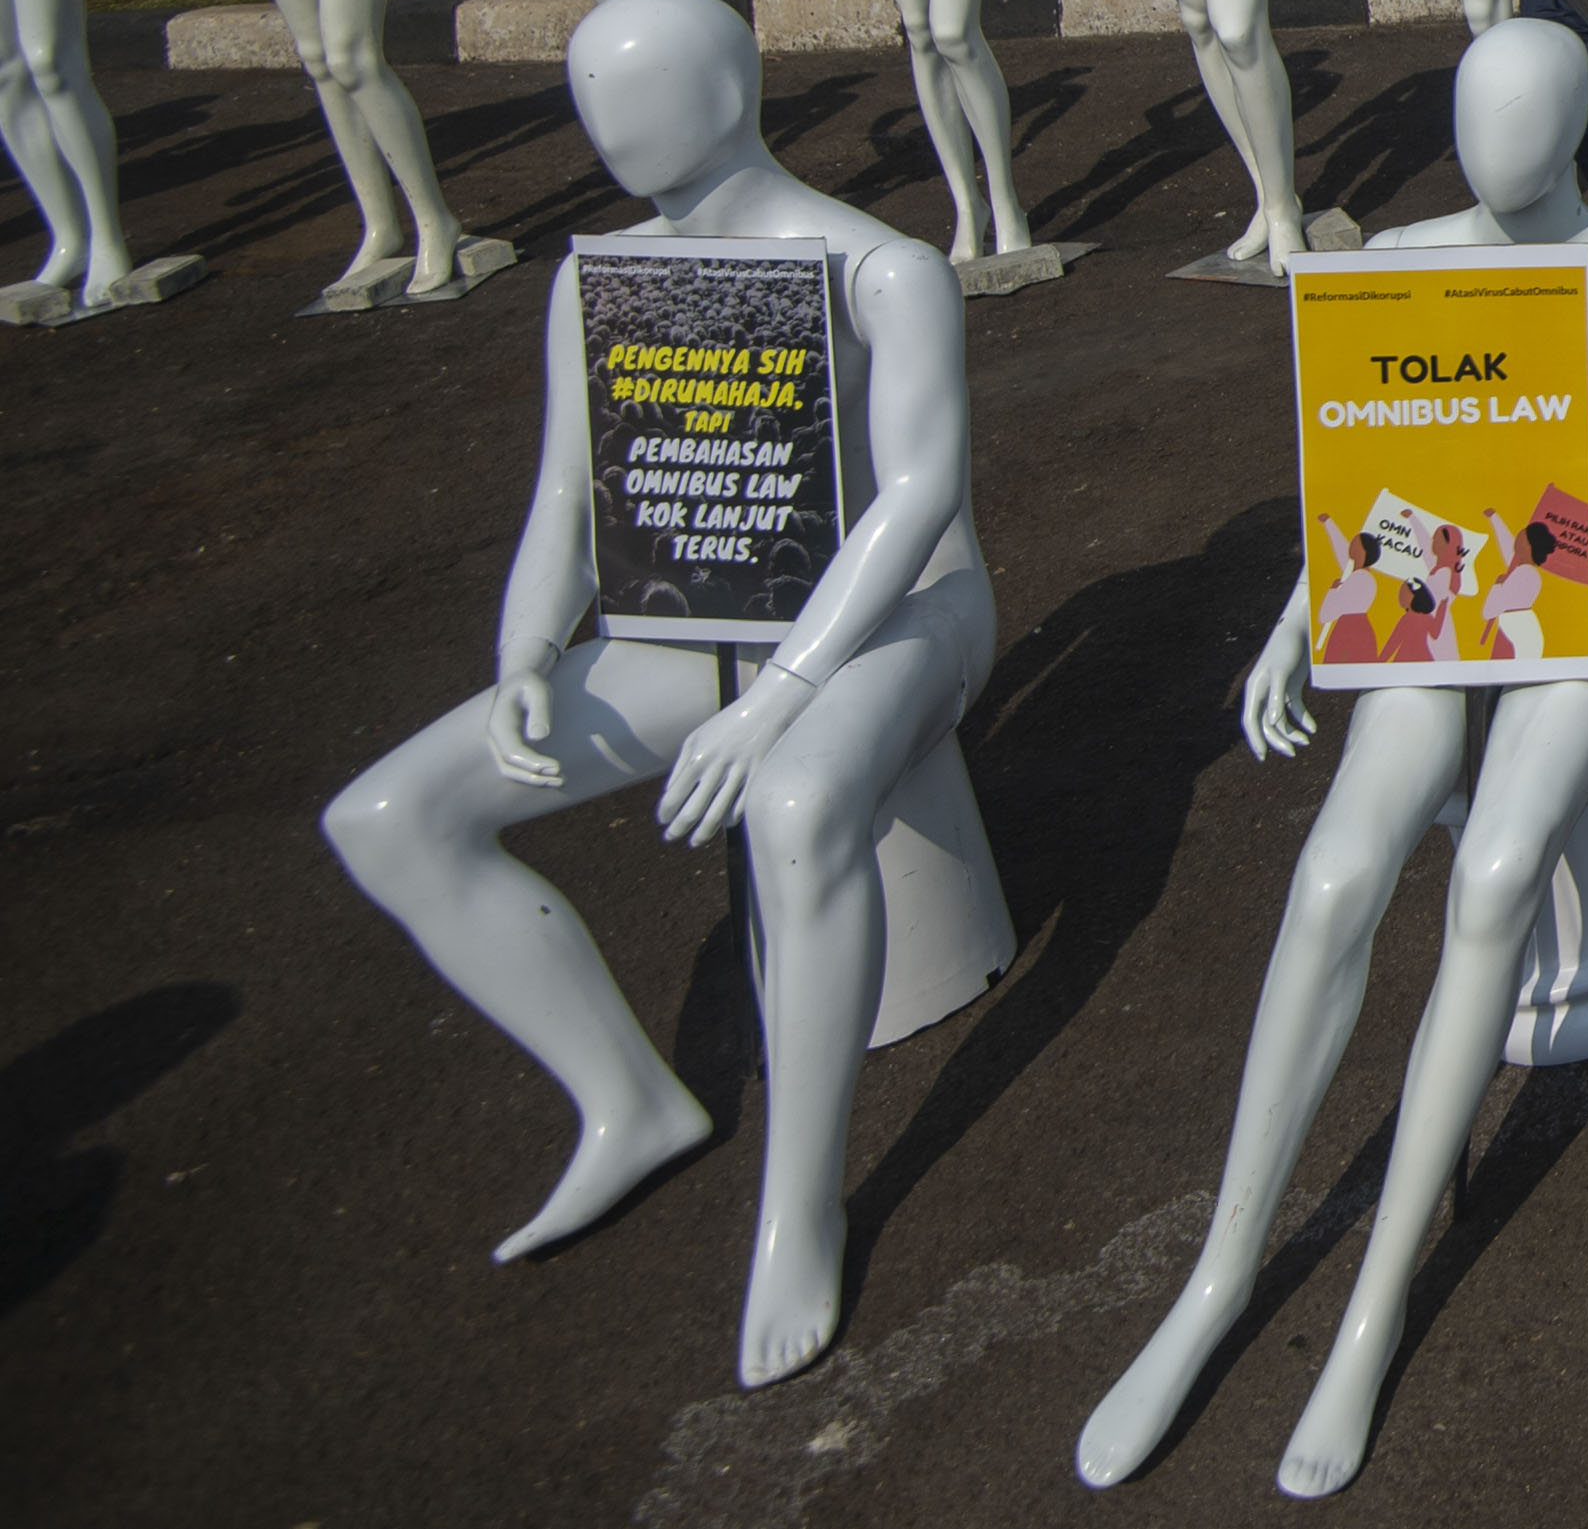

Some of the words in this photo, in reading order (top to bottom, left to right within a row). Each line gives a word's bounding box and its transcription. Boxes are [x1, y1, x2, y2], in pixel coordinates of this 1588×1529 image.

[1303, 289, 1411, 303] #ReformasiDikorupsi
[1444, 285, 1578, 299] #AtasiVirusCabutOmnibus
[607, 344, 750, 374] PENGENNYA
[756, 348, 807, 375] SIH
[1371, 352, 1508, 384] TOLAK
[611, 376, 804, 411] #DIRUMAHAJA,
[684, 411, 731, 433] TAPI
[1319, 396, 1481, 428] OMNIBUS
[1489, 393, 1572, 424] LAW
[628, 436, 793, 467] PEMBAHASAN
[625, 469, 739, 498] OMNIBUS
[745, 473, 802, 499] LAW
[636, 500, 686, 528] KOK
[695, 504, 793, 532] LANJUT
[672, 534, 760, 564] TERUS.
